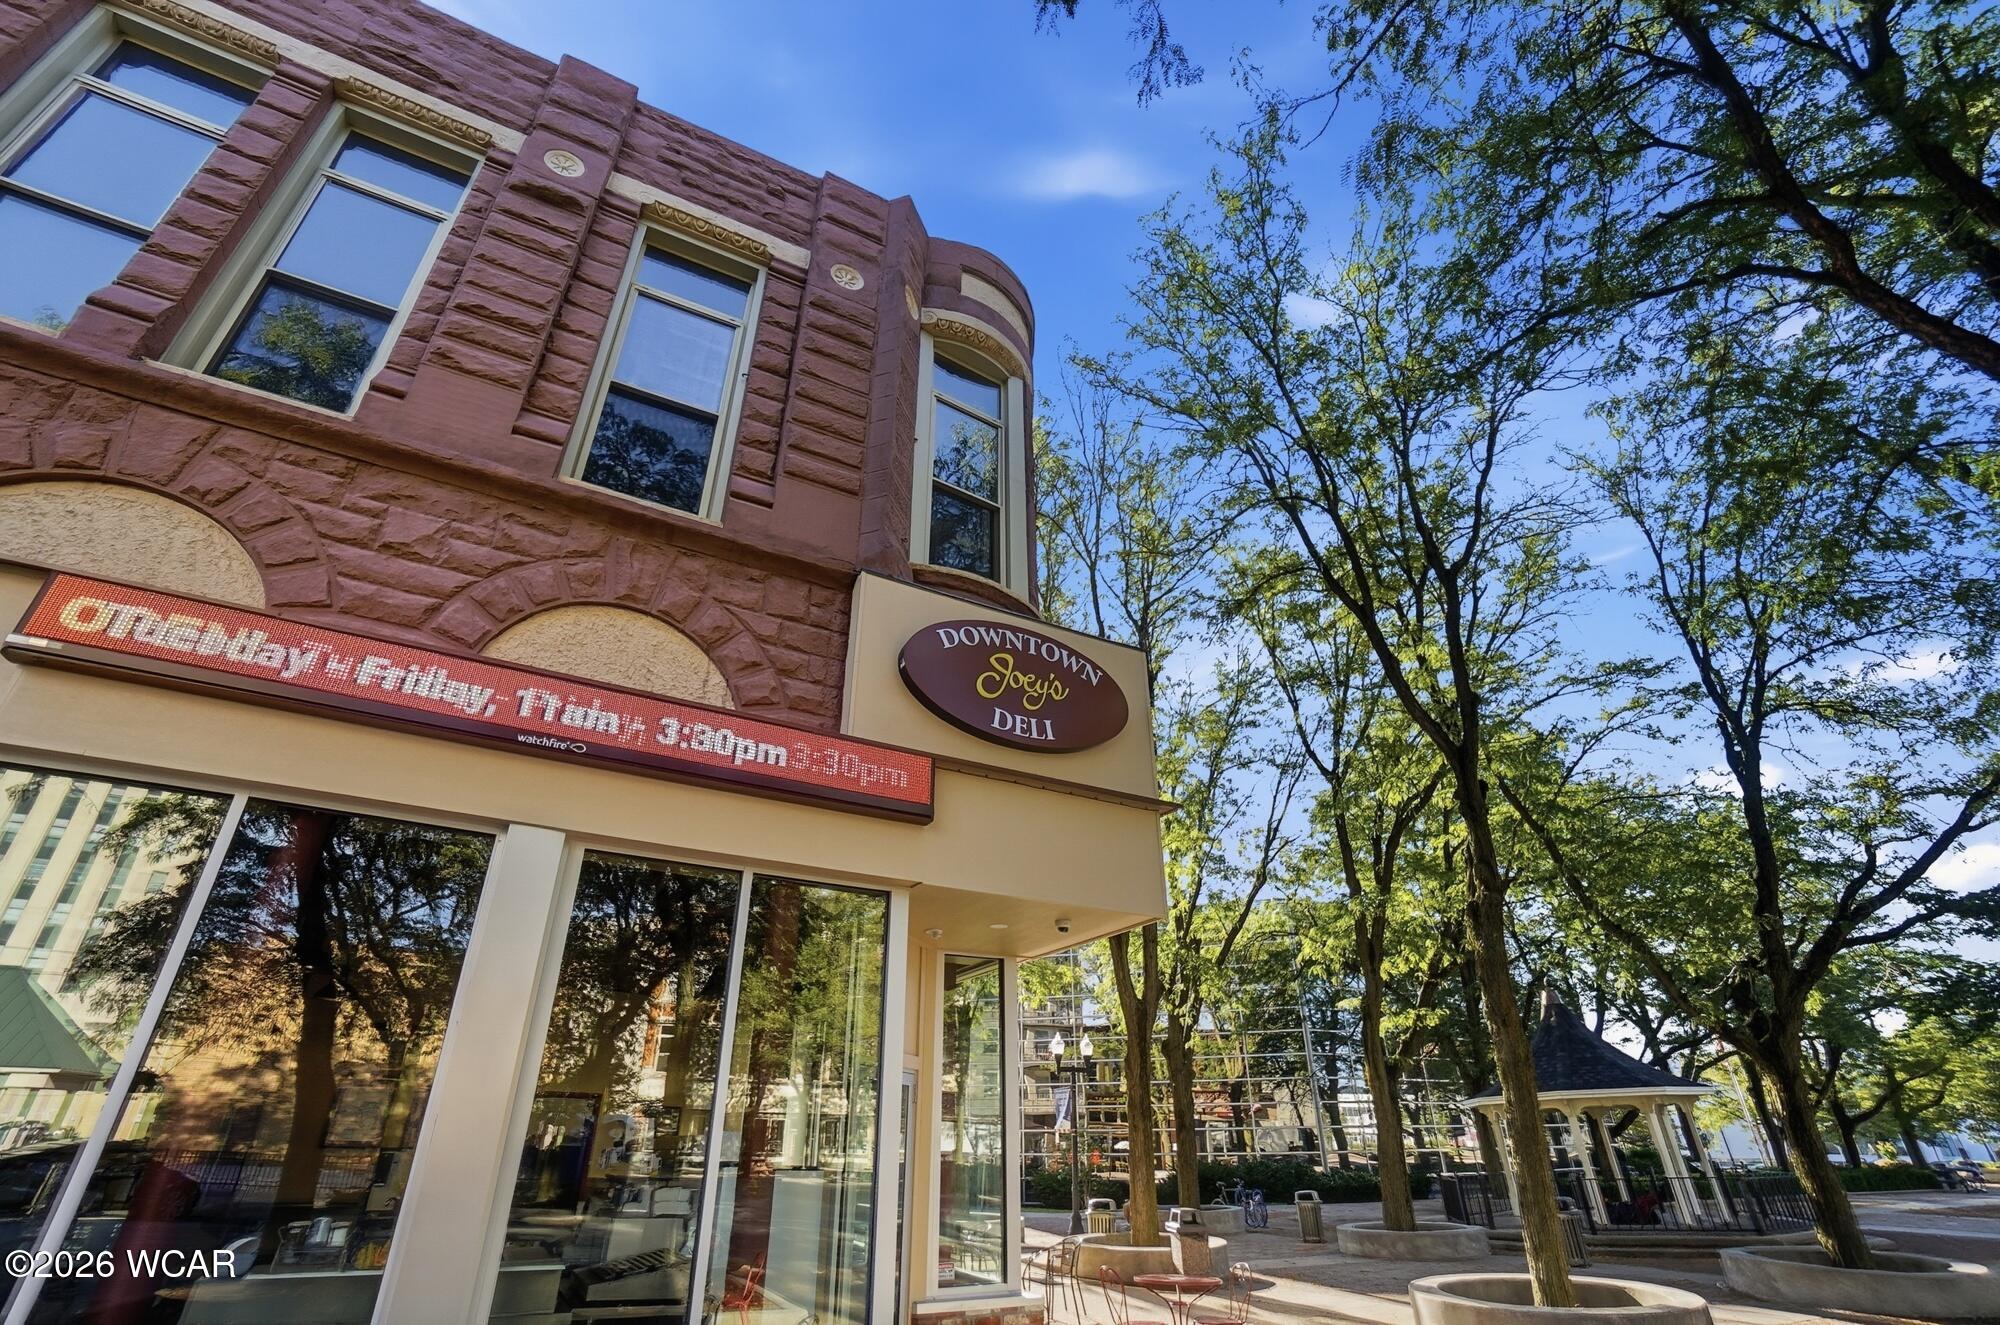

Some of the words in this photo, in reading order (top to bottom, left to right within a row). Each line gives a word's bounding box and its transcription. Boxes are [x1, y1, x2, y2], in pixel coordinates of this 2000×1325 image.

[936, 626, 1103, 687] DOWNTOWN
[975, 653, 1070, 710] Joey's
[517, 733, 568, 750] watchfire
[991, 707, 1056, 741] DELI
